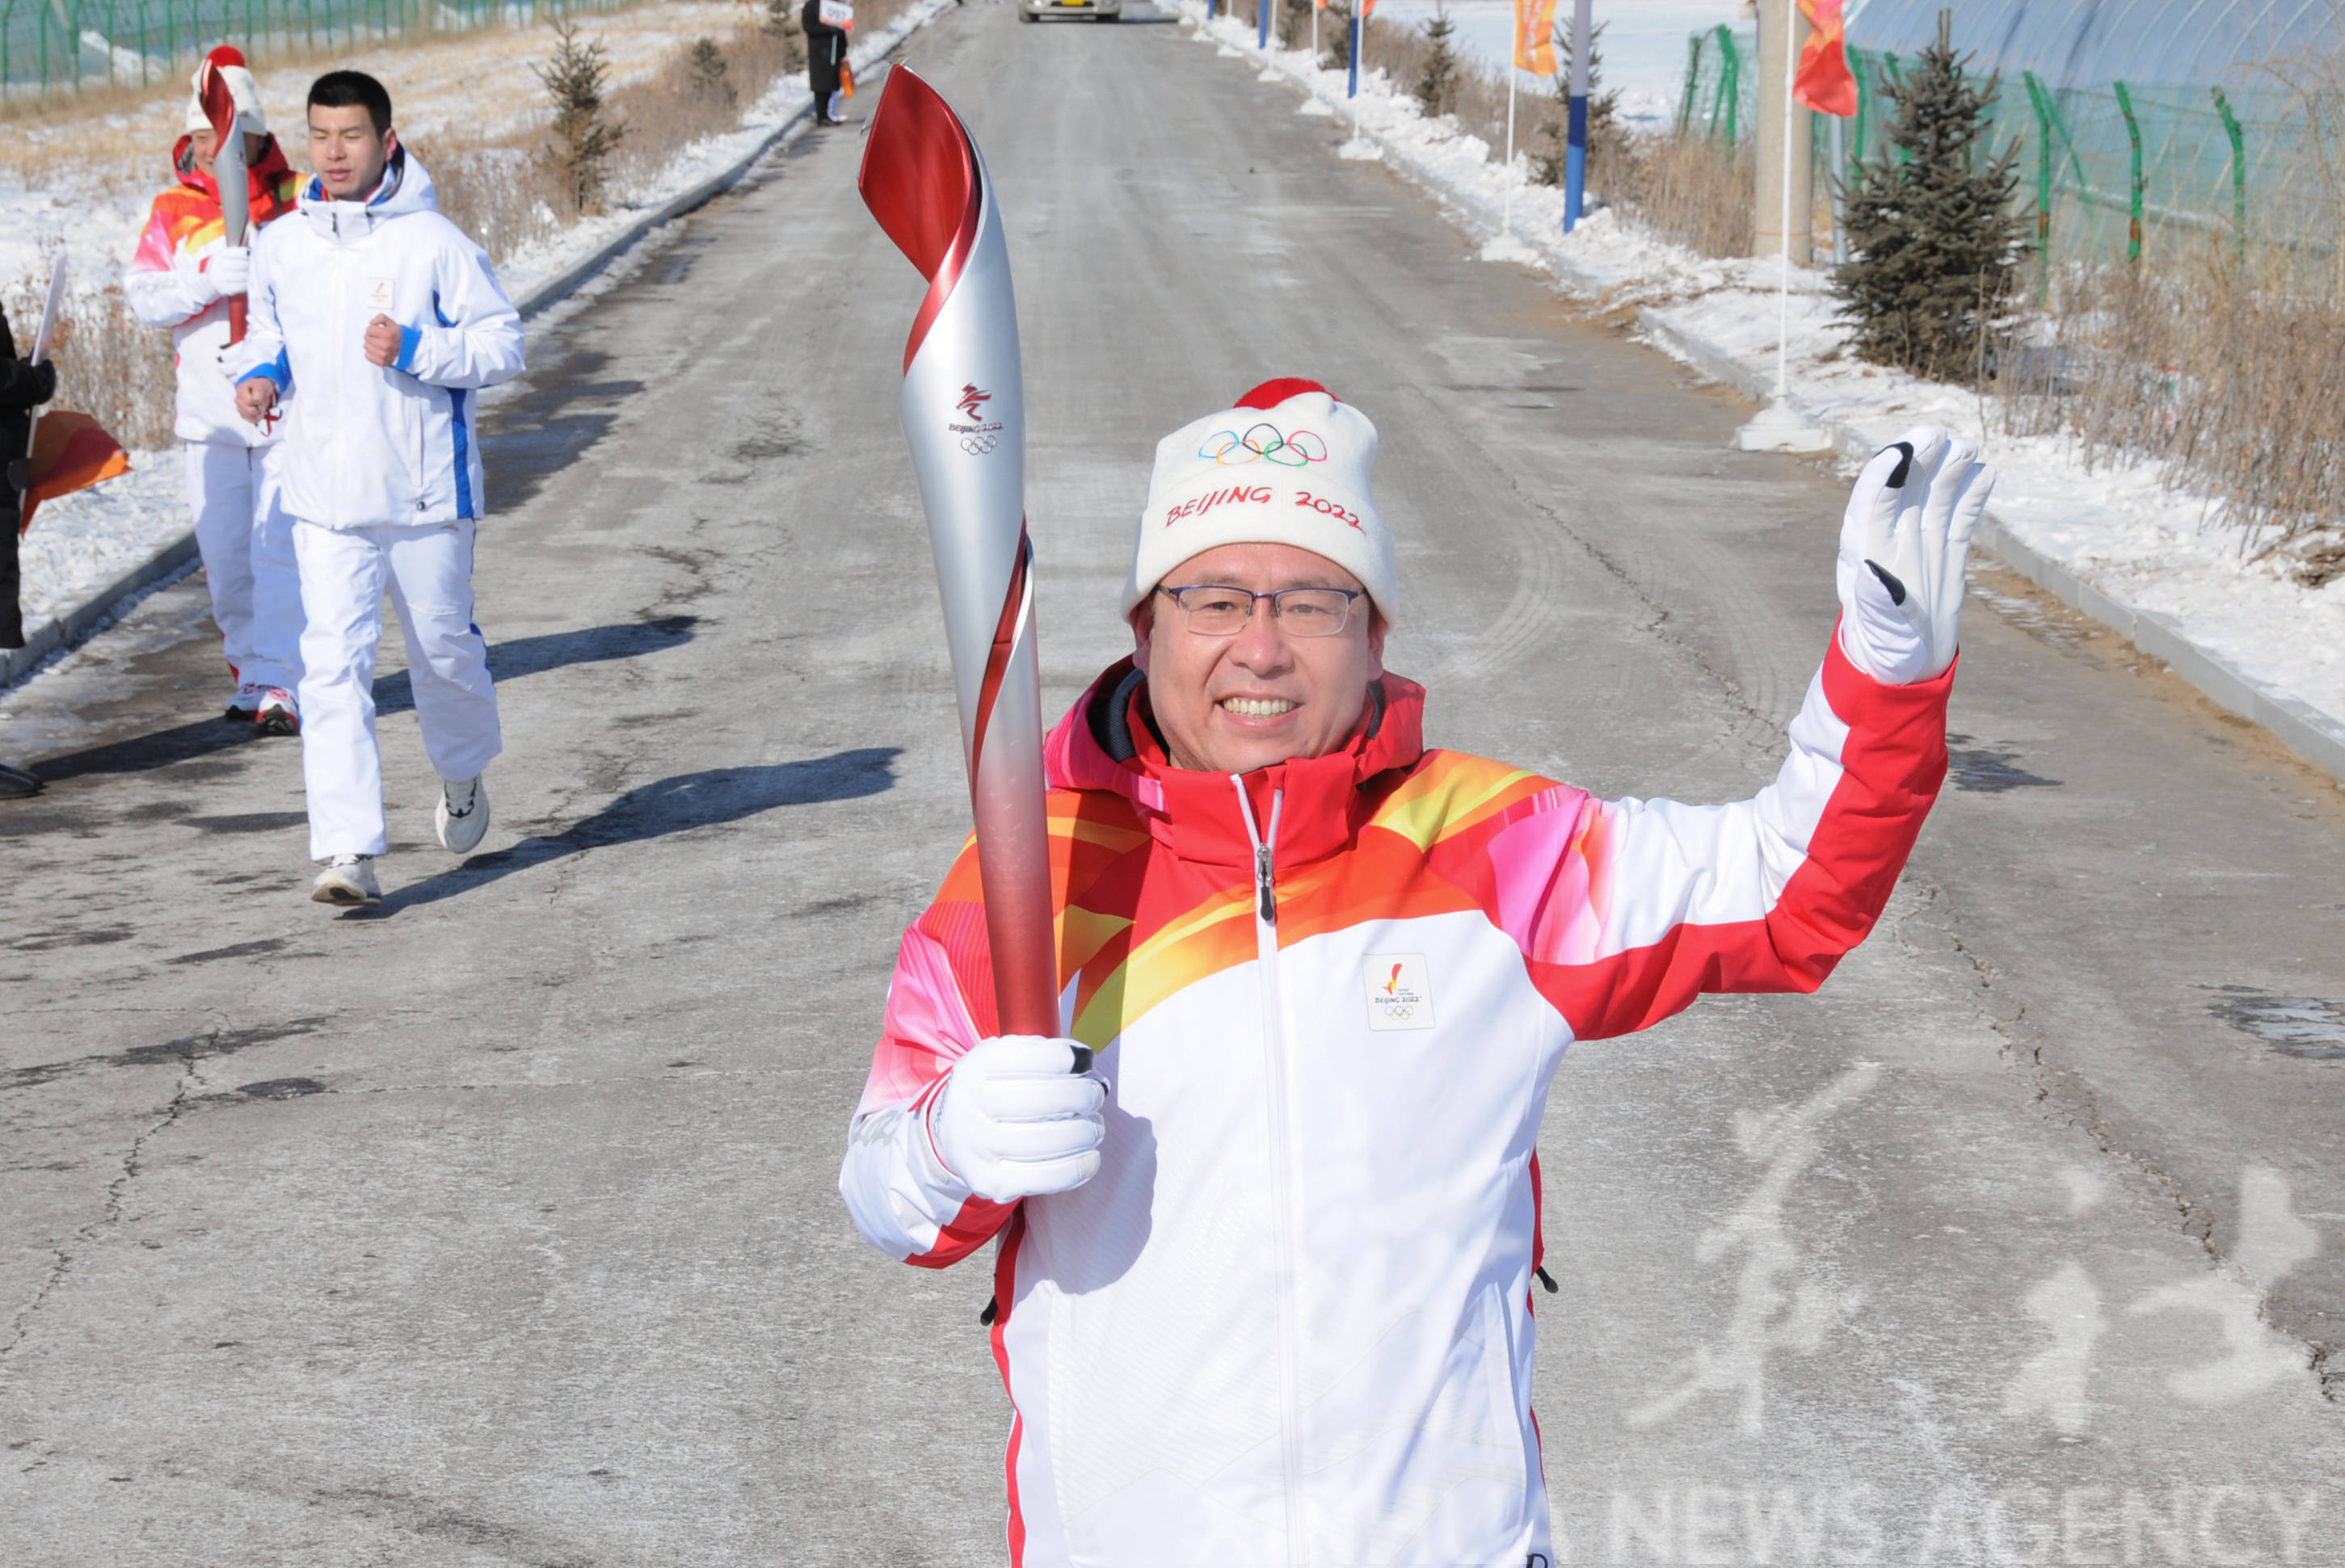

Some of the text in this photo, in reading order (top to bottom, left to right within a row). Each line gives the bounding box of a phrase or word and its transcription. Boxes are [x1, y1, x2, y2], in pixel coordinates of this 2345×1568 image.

[949, 422, 1004, 434] BEIJING 2022
[1165, 486, 1367, 536] BEIJING 2022
